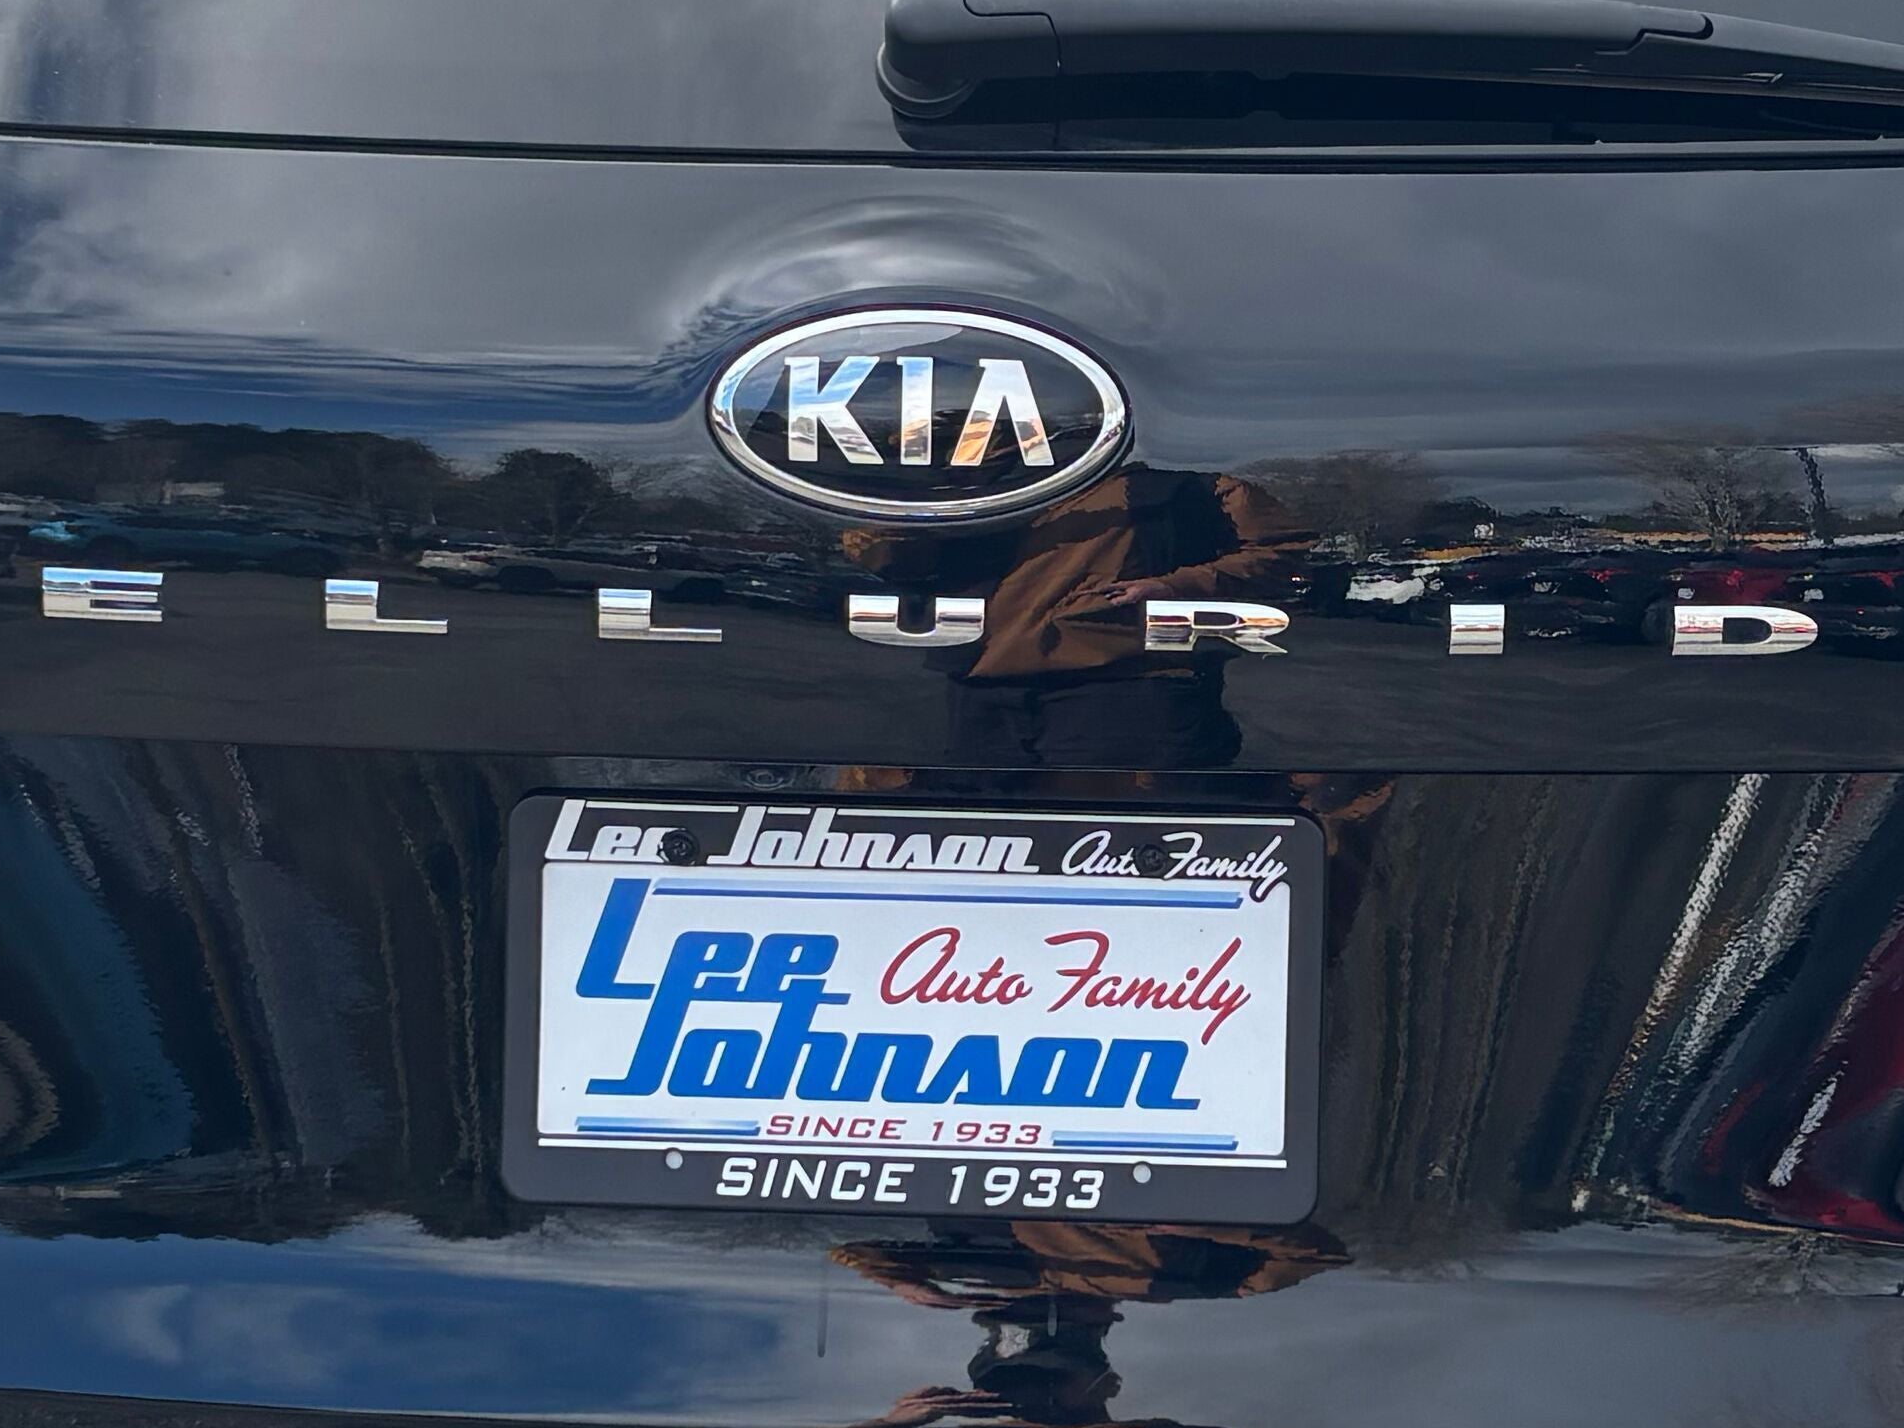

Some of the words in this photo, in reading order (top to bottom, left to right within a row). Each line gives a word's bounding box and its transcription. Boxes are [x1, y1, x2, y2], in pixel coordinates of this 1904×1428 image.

[783, 355, 1056, 468] KIA
[706, 805, 1040, 873] Johnson
[1060, 829, 1143, 877] Aut
[1162, 831, 1288, 900] Family
[576, 878, 844, 1002] Lee
[880, 926, 1033, 1005] Auto
[1044, 930, 1252, 1046] Family
[585, 993, 1200, 1109] Johnson
[765, 1114, 909, 1142] SINCE
[929, 1119, 1043, 1147] 1933
[715, 1156, 914, 1205] SINCE
[947, 1164, 1106, 1211] 1933
